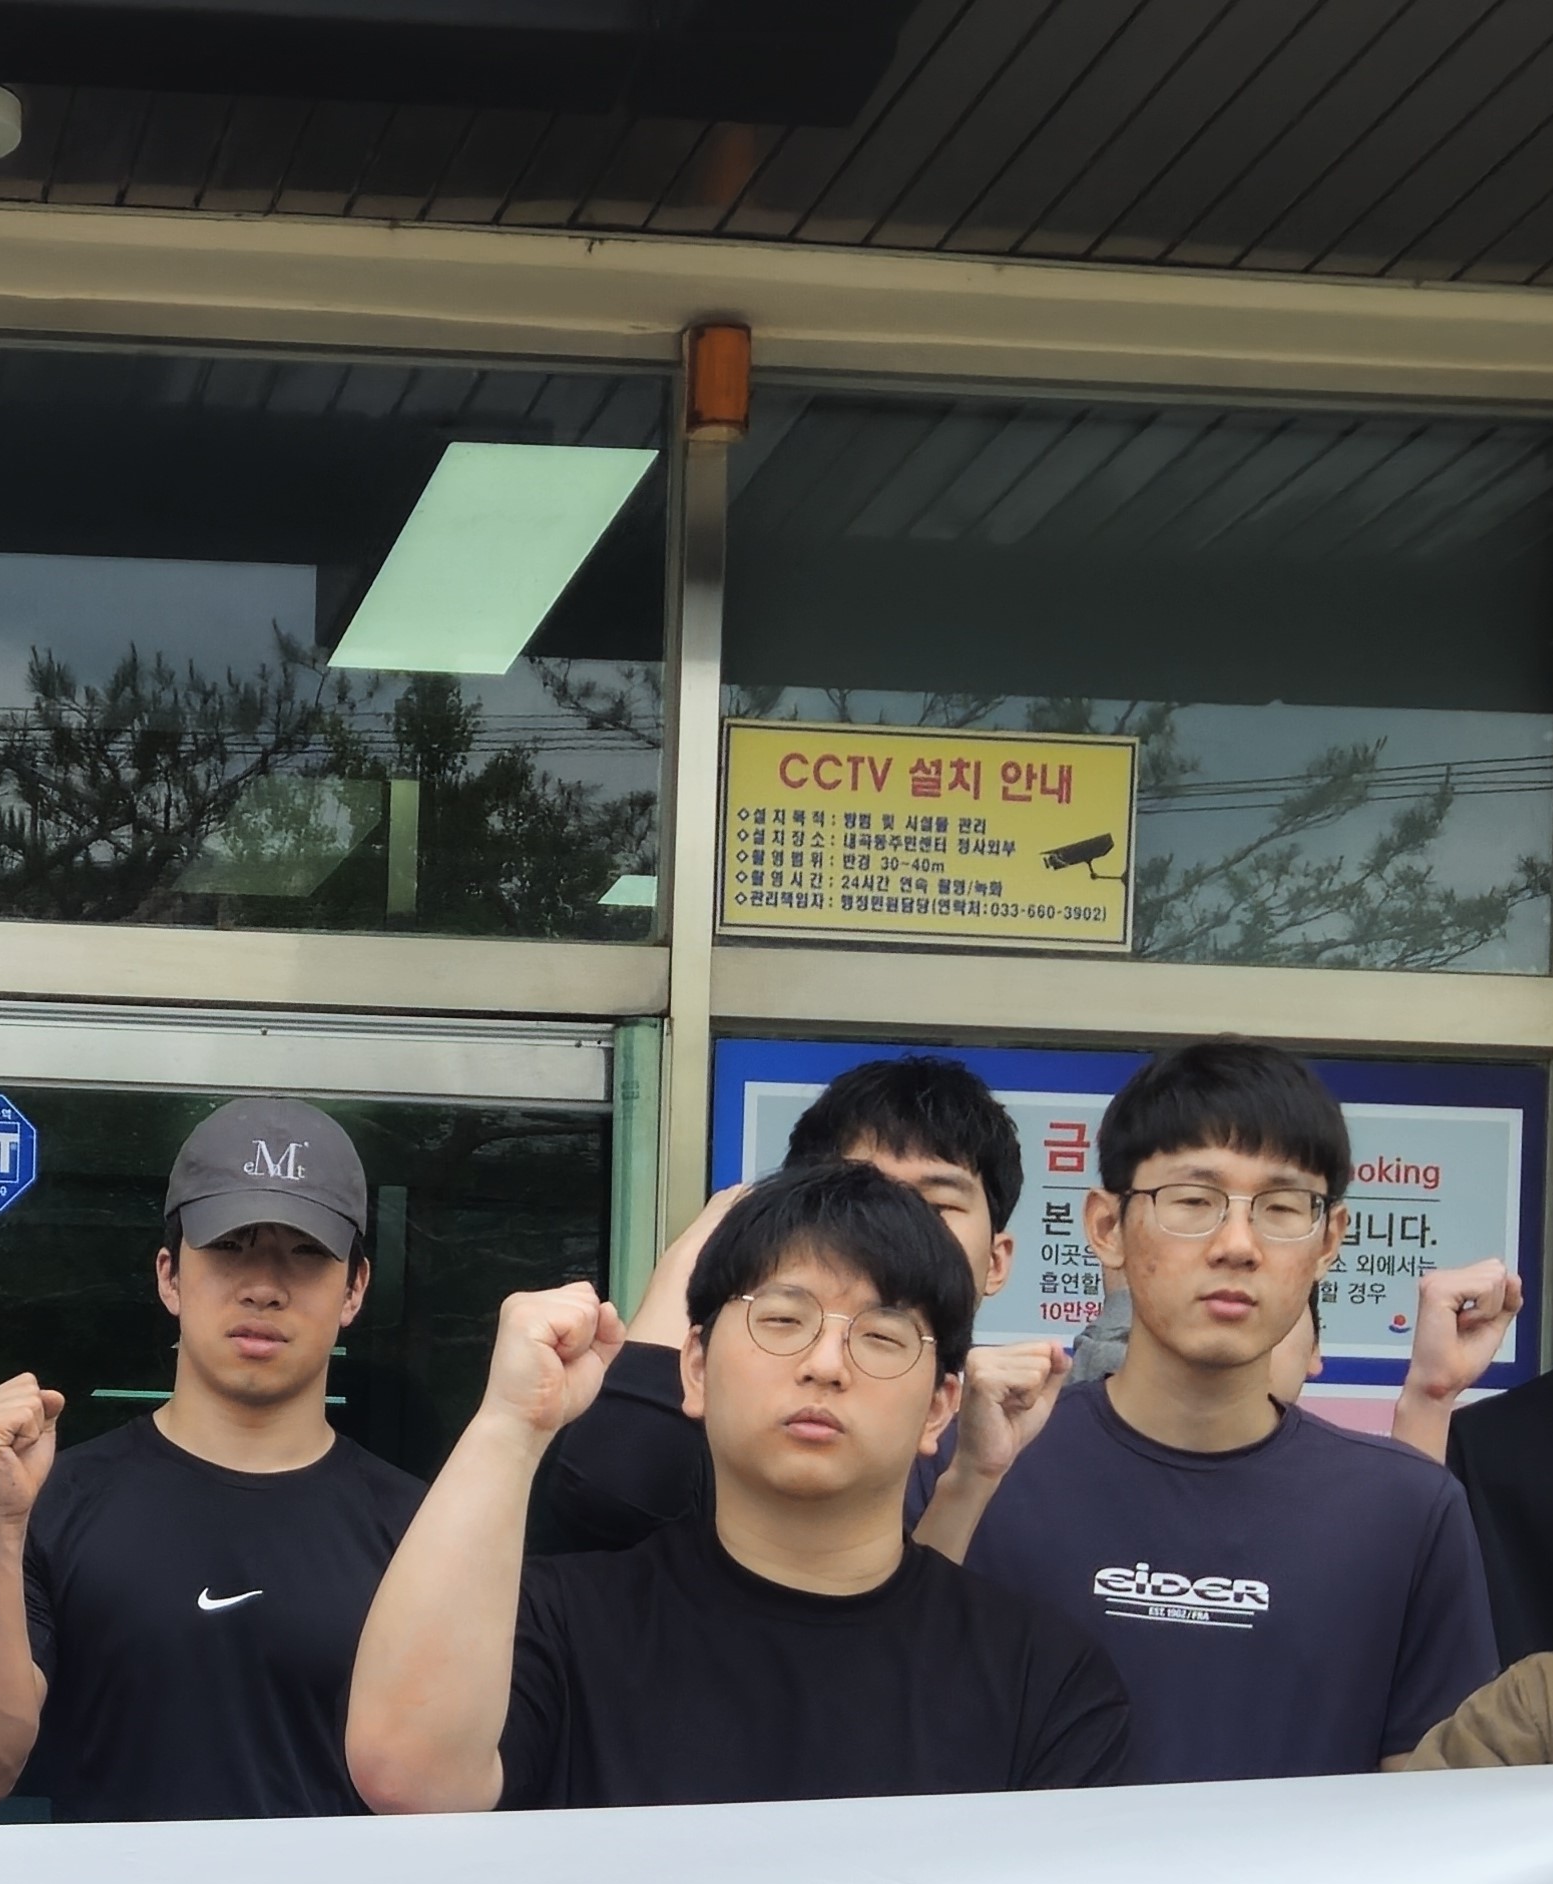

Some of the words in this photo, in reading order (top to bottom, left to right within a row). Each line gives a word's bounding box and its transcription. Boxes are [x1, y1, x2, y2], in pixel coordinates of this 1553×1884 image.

[779, 752, 893, 792] CCTV
[909, 758, 981, 800] 설치
[1001, 760, 1072, 804] 안내
[1044, 1122, 1090, 1172] 금
[1042, 1202, 1073, 1236] 본
[1348, 1282, 1386, 1304] 경우
